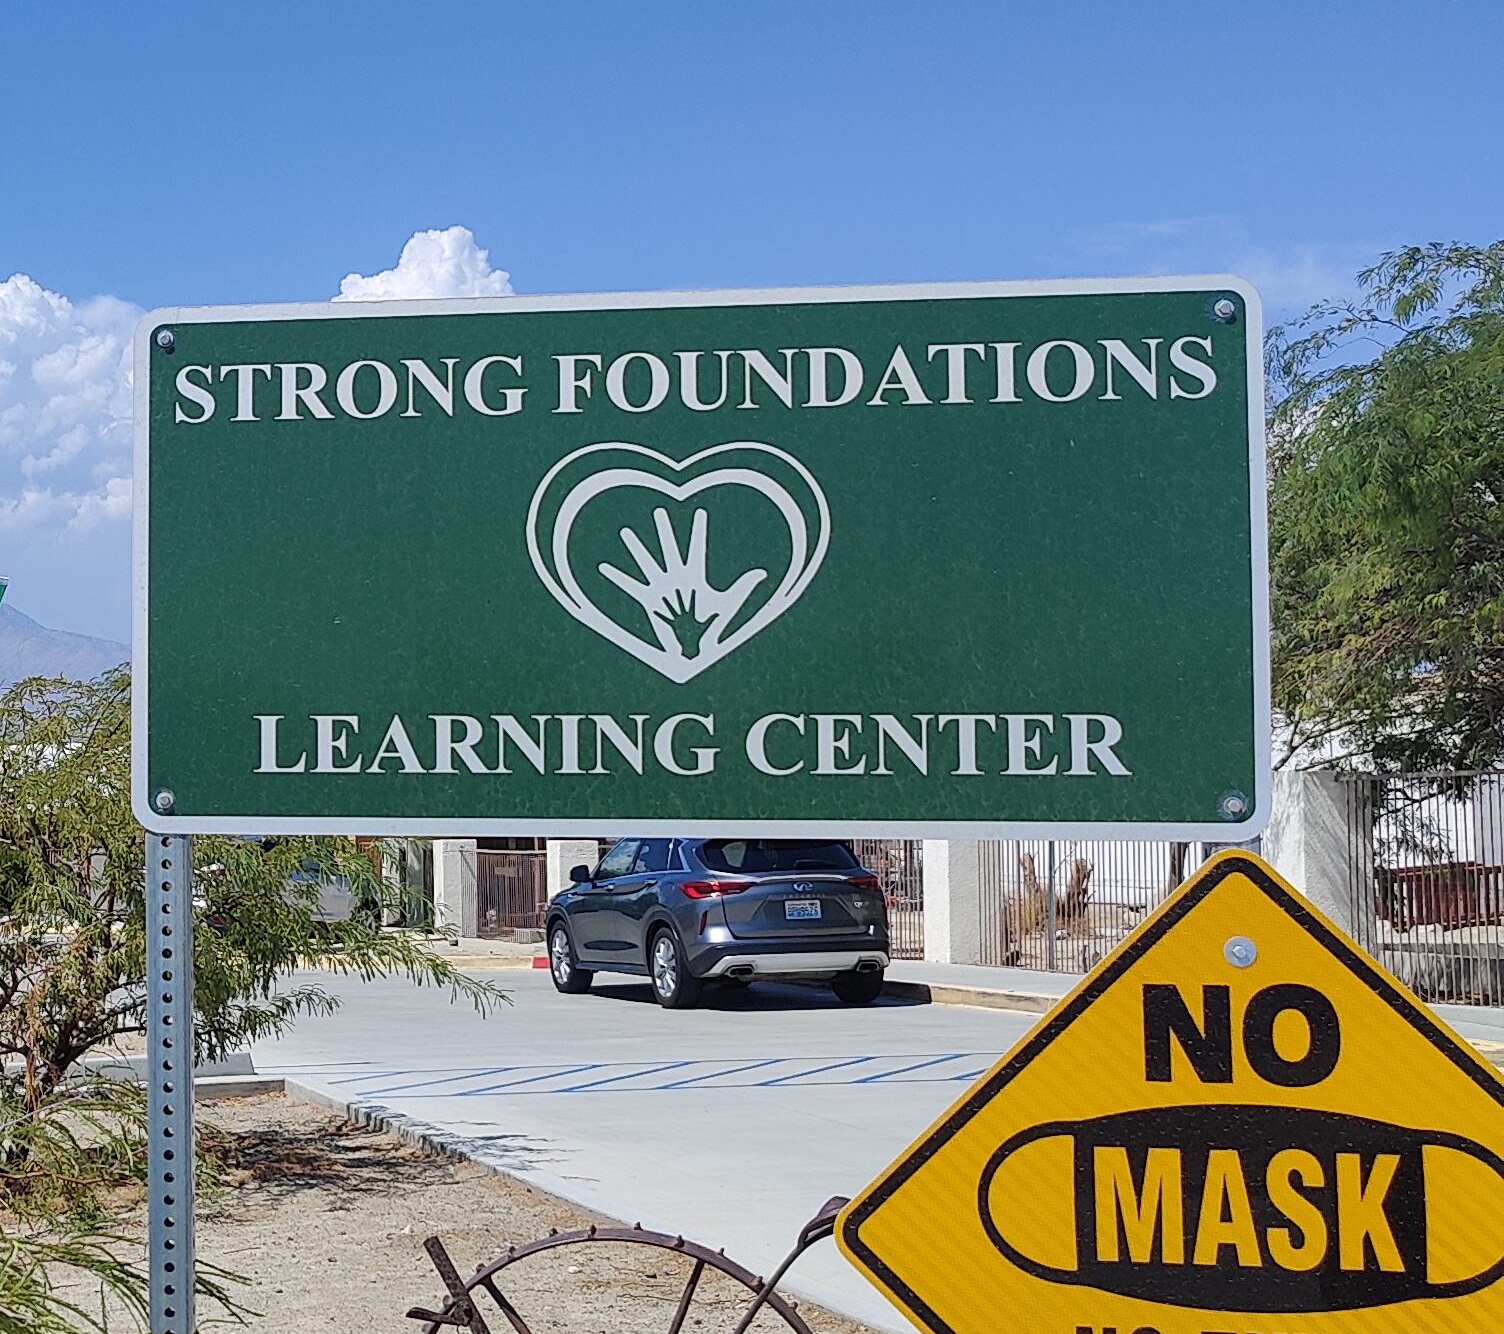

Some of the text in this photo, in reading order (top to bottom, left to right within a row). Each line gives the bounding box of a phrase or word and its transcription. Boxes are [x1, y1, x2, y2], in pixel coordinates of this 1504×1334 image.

[175, 335, 1217, 424] STRONG FOUNDATIONS
[253, 713, 1133, 776] LEARNING CENTER
[1142, 983, 1342, 1088] NO
[1093, 1146, 1406, 1273] MASK
